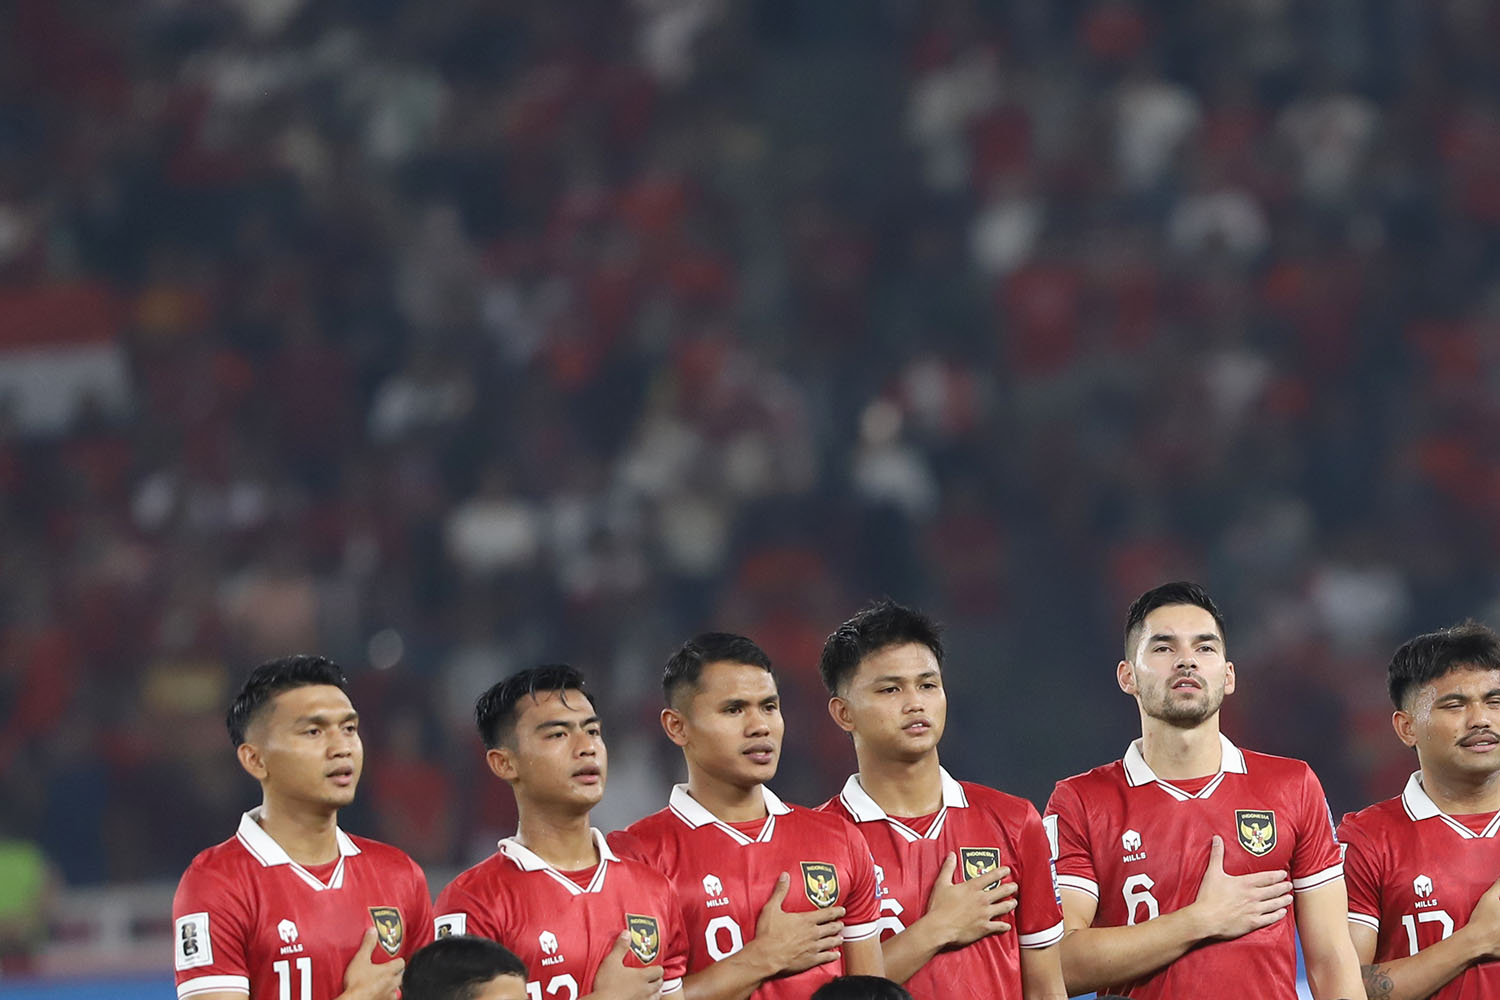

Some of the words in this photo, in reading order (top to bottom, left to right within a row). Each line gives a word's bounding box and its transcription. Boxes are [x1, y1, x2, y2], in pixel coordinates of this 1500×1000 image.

[1122, 852, 1147, 863] MILLS
[706, 897, 730, 908] MILLS
[1122, 873, 1160, 926] 6
[1414, 898, 1438, 909] MILLS
[280, 943, 304, 955] MILLS
[541, 954, 565, 966] MILLS
